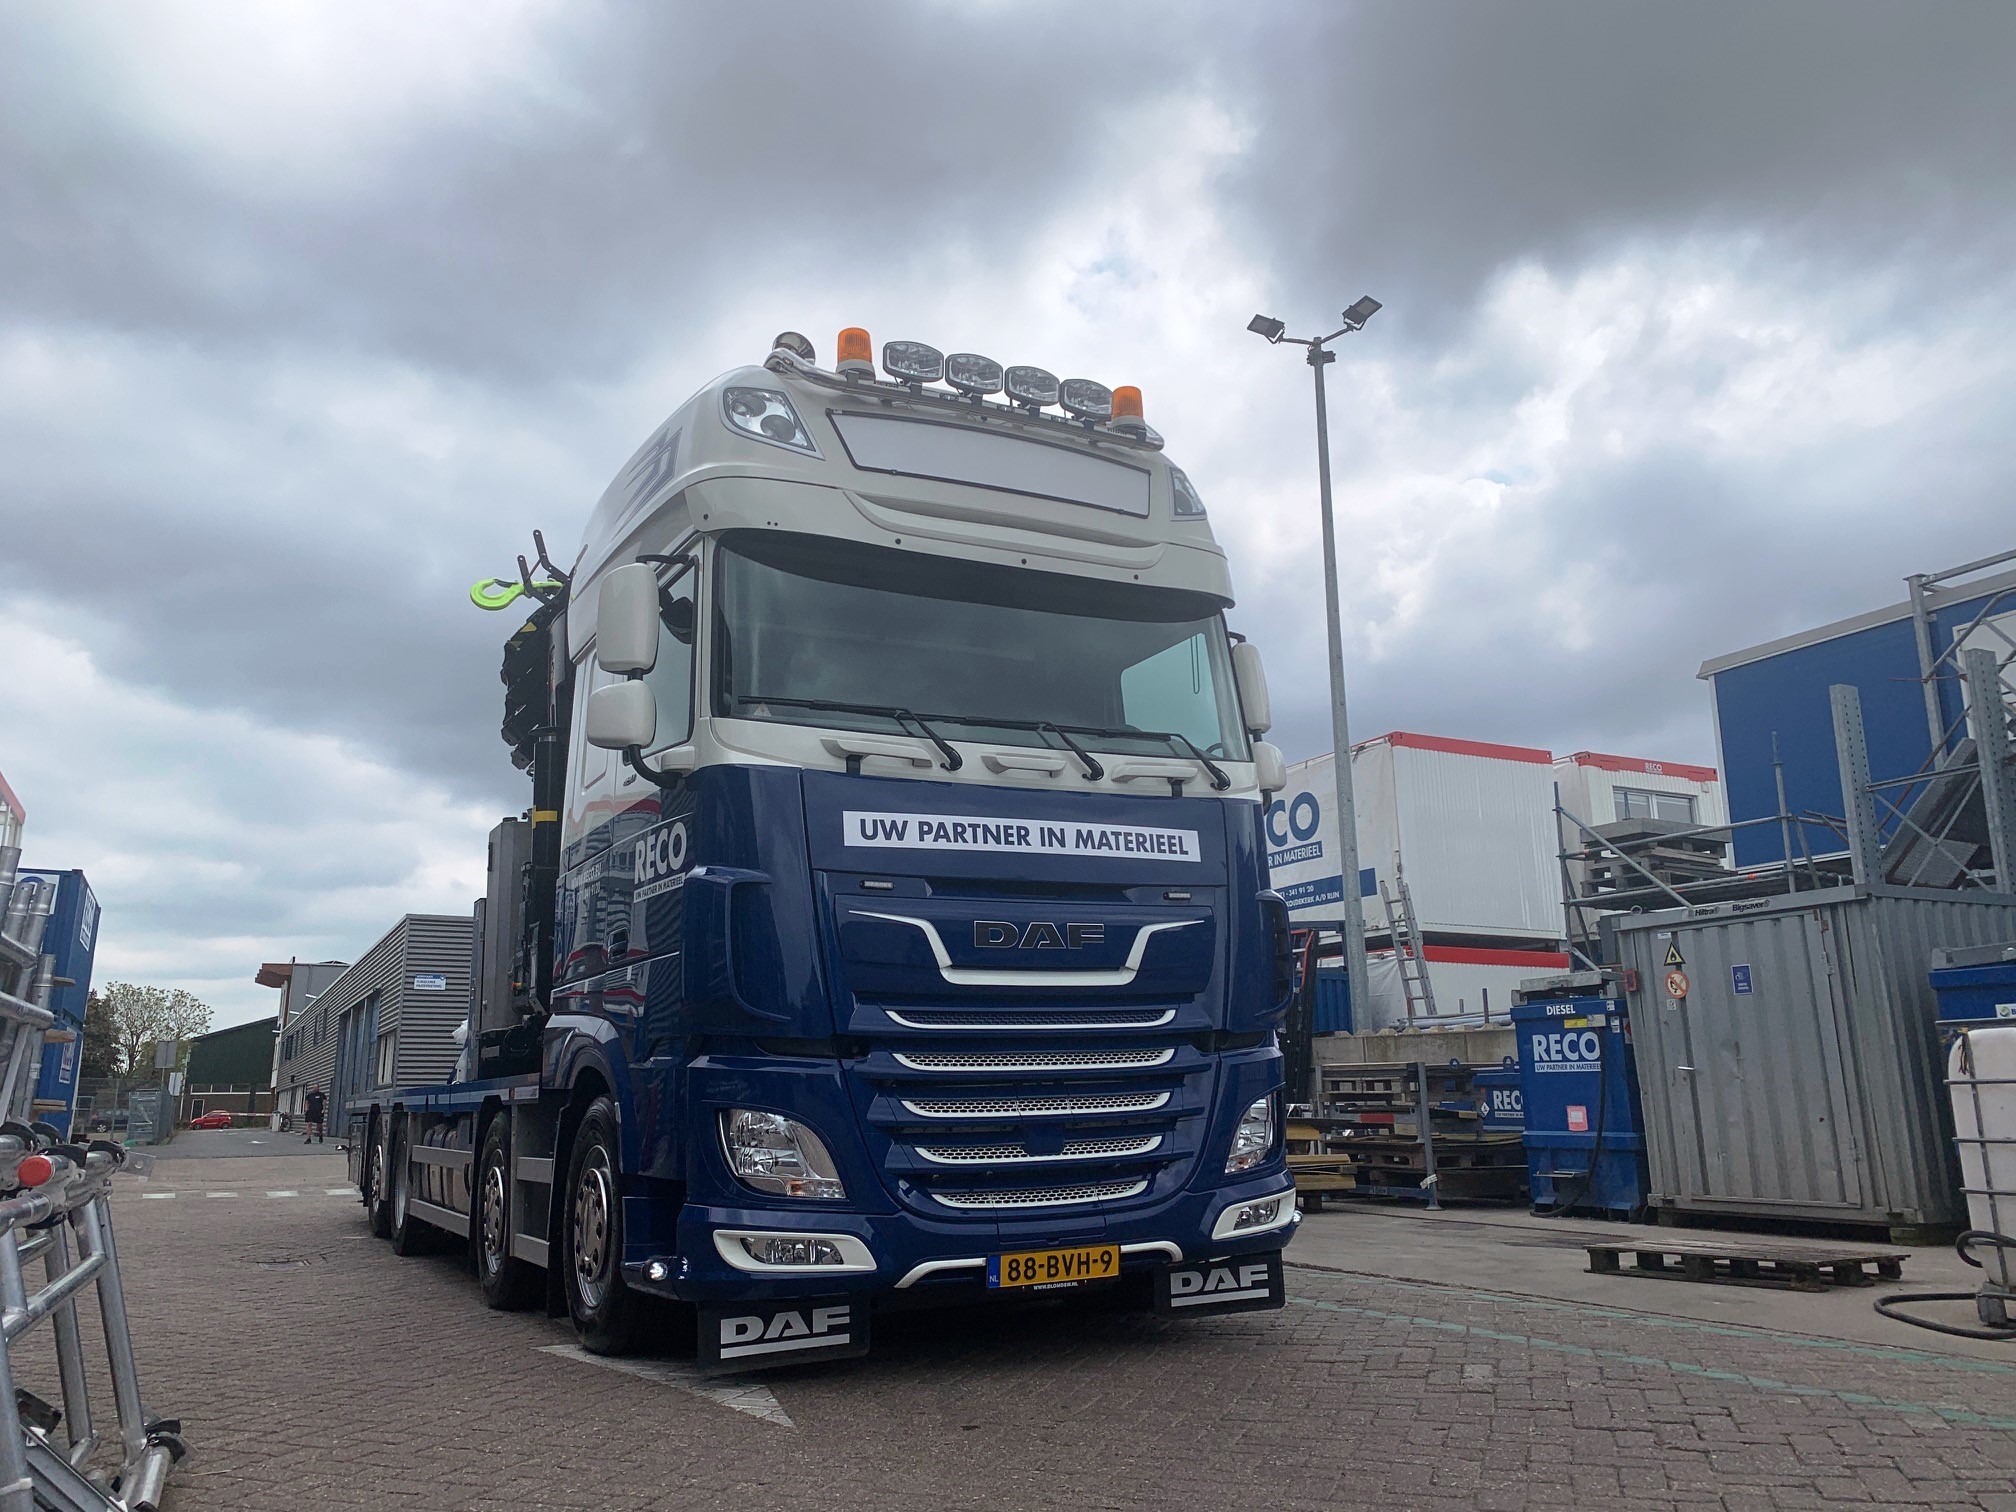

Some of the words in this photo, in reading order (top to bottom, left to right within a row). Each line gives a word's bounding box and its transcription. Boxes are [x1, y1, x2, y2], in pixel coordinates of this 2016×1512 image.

[1644, 762, 1663, 771] RECO
[859, 818, 908, 841] UW
[917, 820, 1032, 847] PARTNER
[1039, 826, 1066, 848] IN
[1075, 828, 1189, 855] MATERIEEL
[634, 821, 687, 885] RECO
[1274, 854, 1283, 867] IN
[1283, 844, 1321, 863] MATERIEEL
[1289, 888, 1298, 896] 341
[1299, 886, 1306, 894] 91
[973, 920, 1105, 949] DAF
[1546, 1004, 1576, 1016] DIESEL
[1532, 1031, 1601, 1061] RECO
[1546, 1063, 1568, 1071] PARTNER
[1576, 1062, 1601, 1070] MATERIEE
[1493, 1090, 1524, 1110] REC
[989, 1275, 999, 1283] NL
[1007, 1250, 1113, 1282] 88-BVH-9
[1170, 1264, 1269, 1295] DAF
[720, 1305, 850, 1345] DAF
